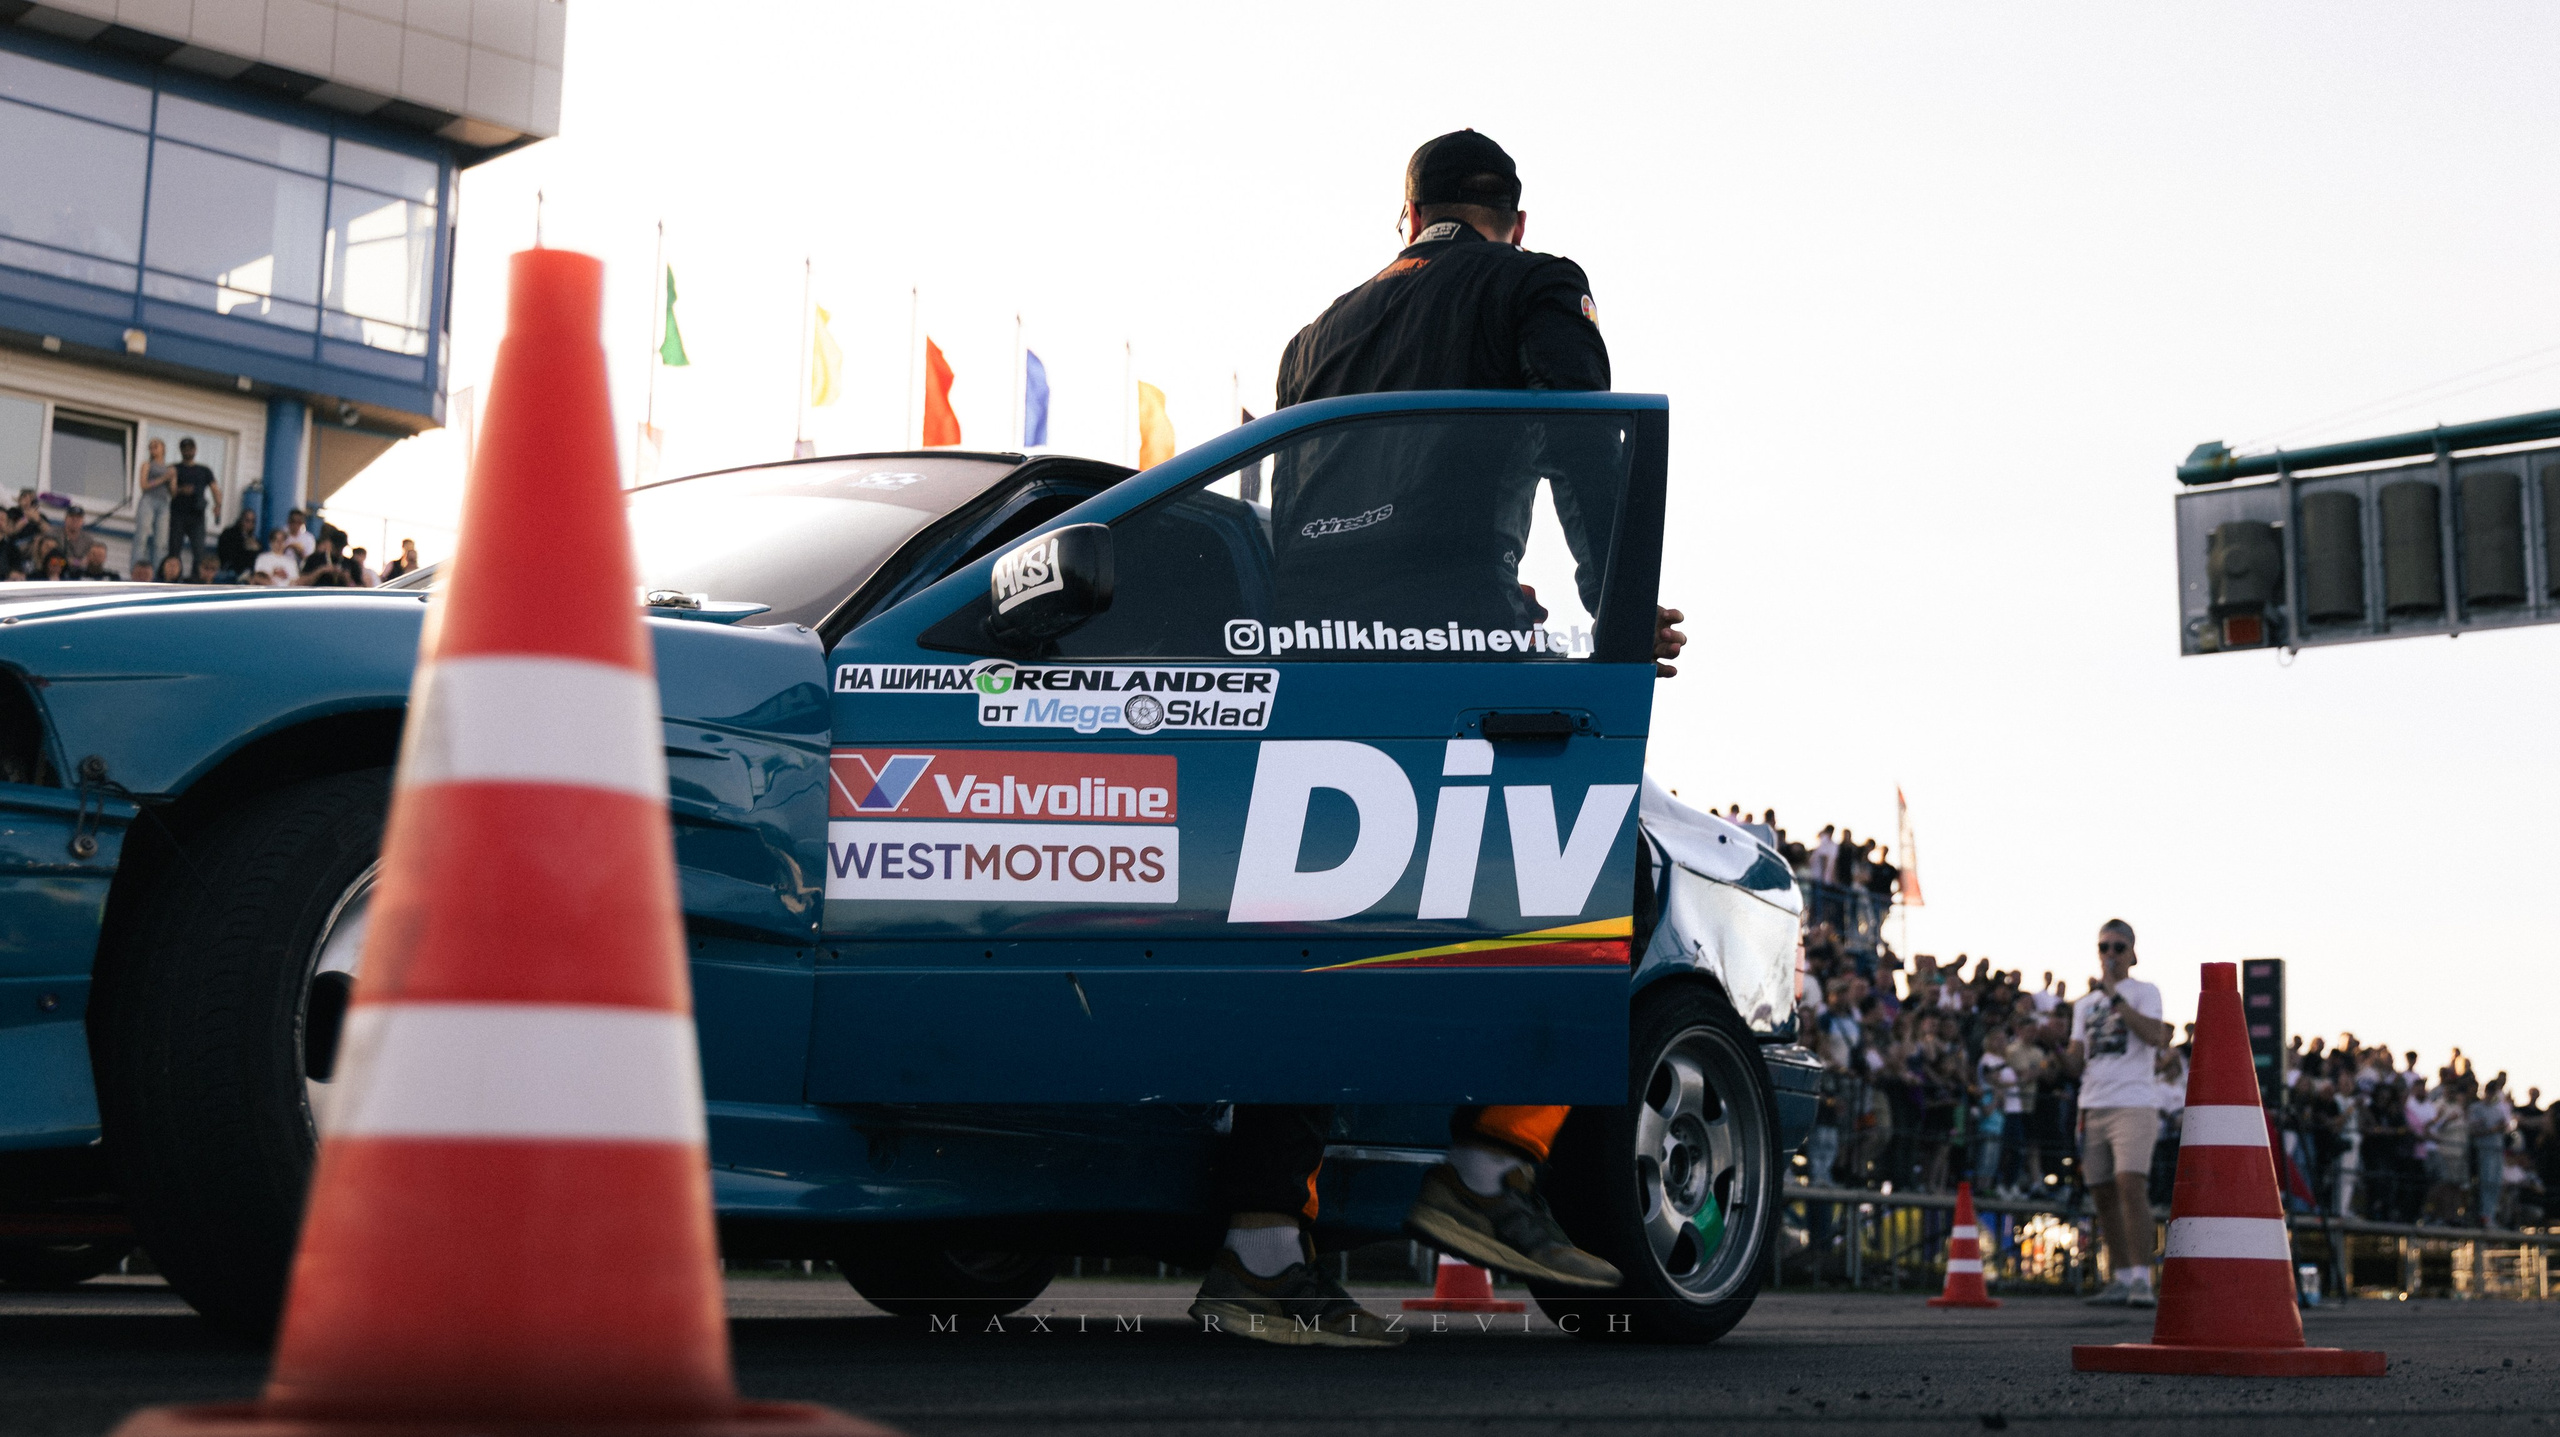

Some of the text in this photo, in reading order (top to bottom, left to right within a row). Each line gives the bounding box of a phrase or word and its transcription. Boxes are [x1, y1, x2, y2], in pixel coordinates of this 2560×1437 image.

[1301, 503, 1394, 539] alpinestars
[1269, 619, 1595, 656] philkhasinevich
[839, 667, 874, 690] НА
[880, 668, 976, 691] ШИНАХ
[1024, 698, 1121, 730] Mega
[1165, 700, 1266, 727] Sklad
[933, 773, 1169, 819] Valvoline
[1227, 739, 1639, 923] Div
[829, 842, 1166, 884] WESTMOTORS
